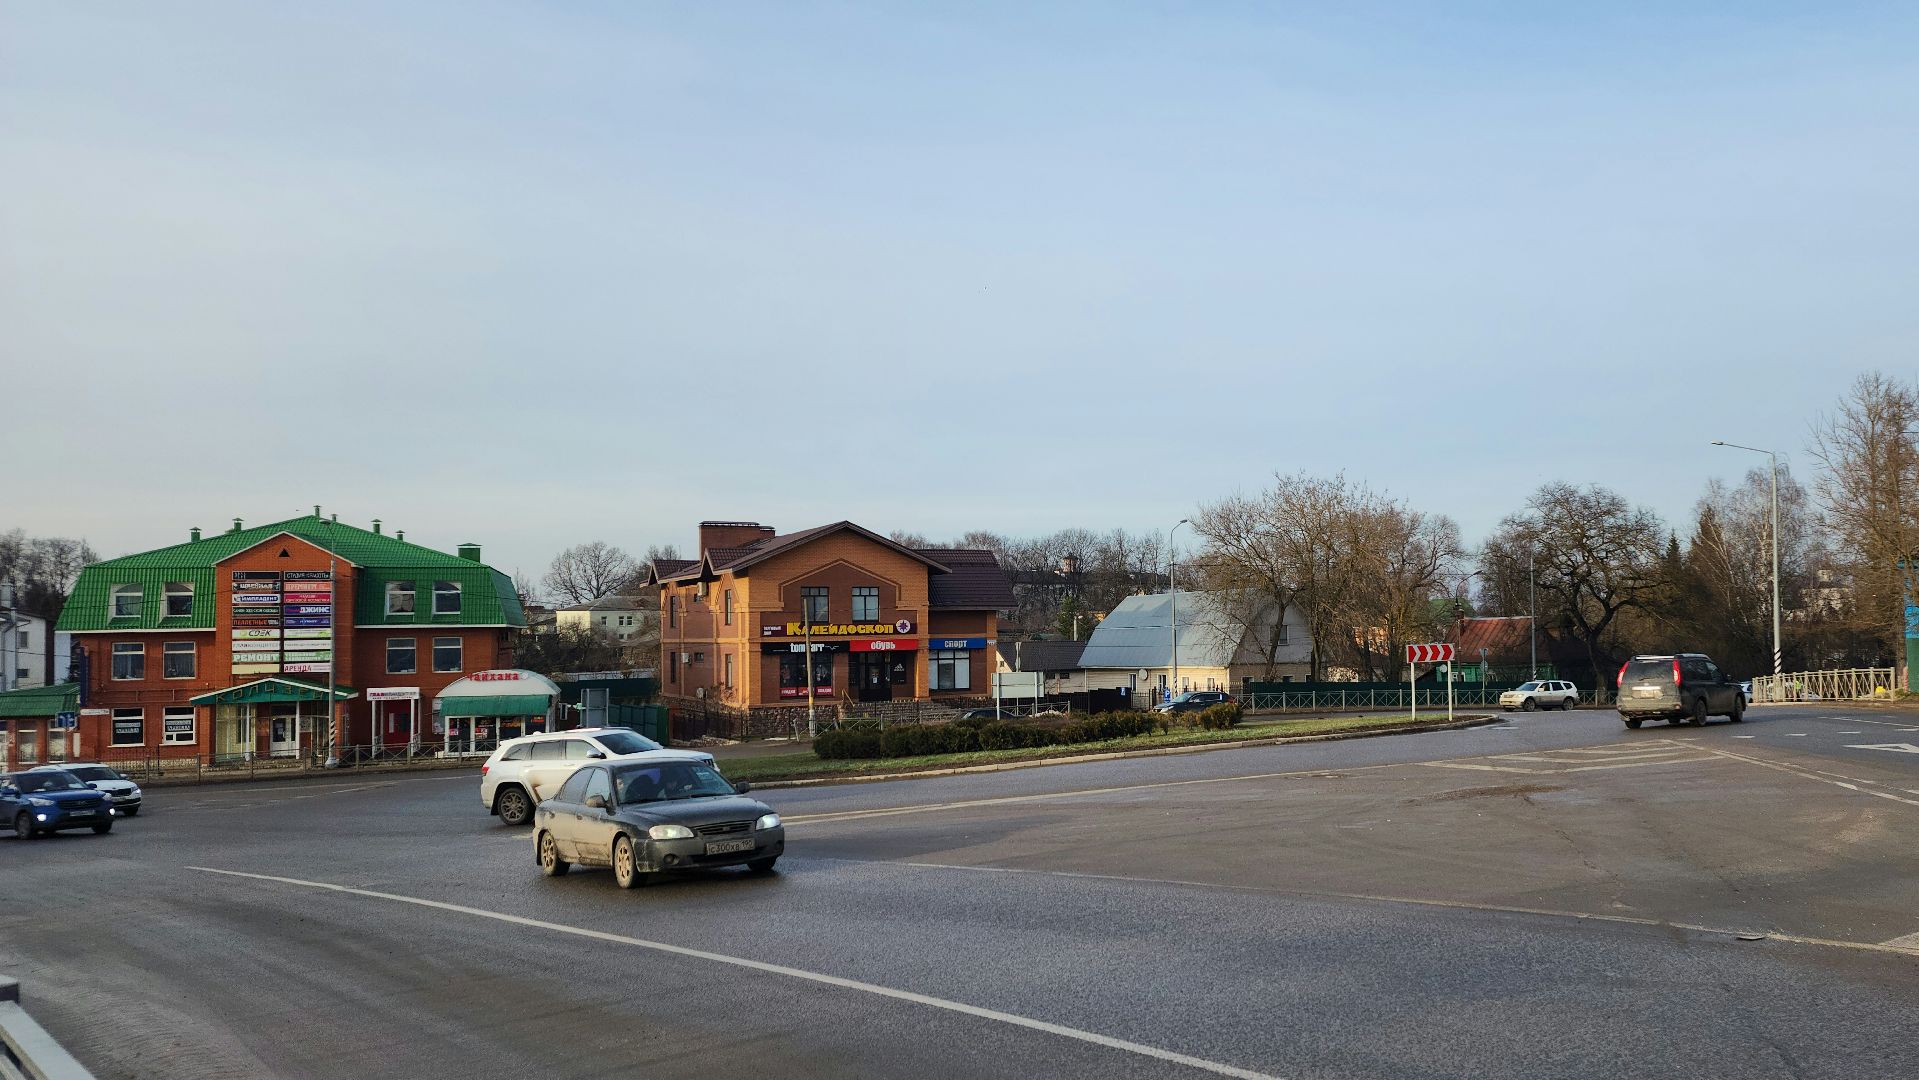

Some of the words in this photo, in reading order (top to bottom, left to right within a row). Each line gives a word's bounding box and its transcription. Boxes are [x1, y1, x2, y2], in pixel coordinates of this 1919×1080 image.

[809, 642, 825, 652] arr
[870, 641, 896, 651] обувь
[944, 640, 968, 649] спорт
[233, 653, 280, 662] РЕМОНТ
[284, 664, 312, 672] АРЕНДА
